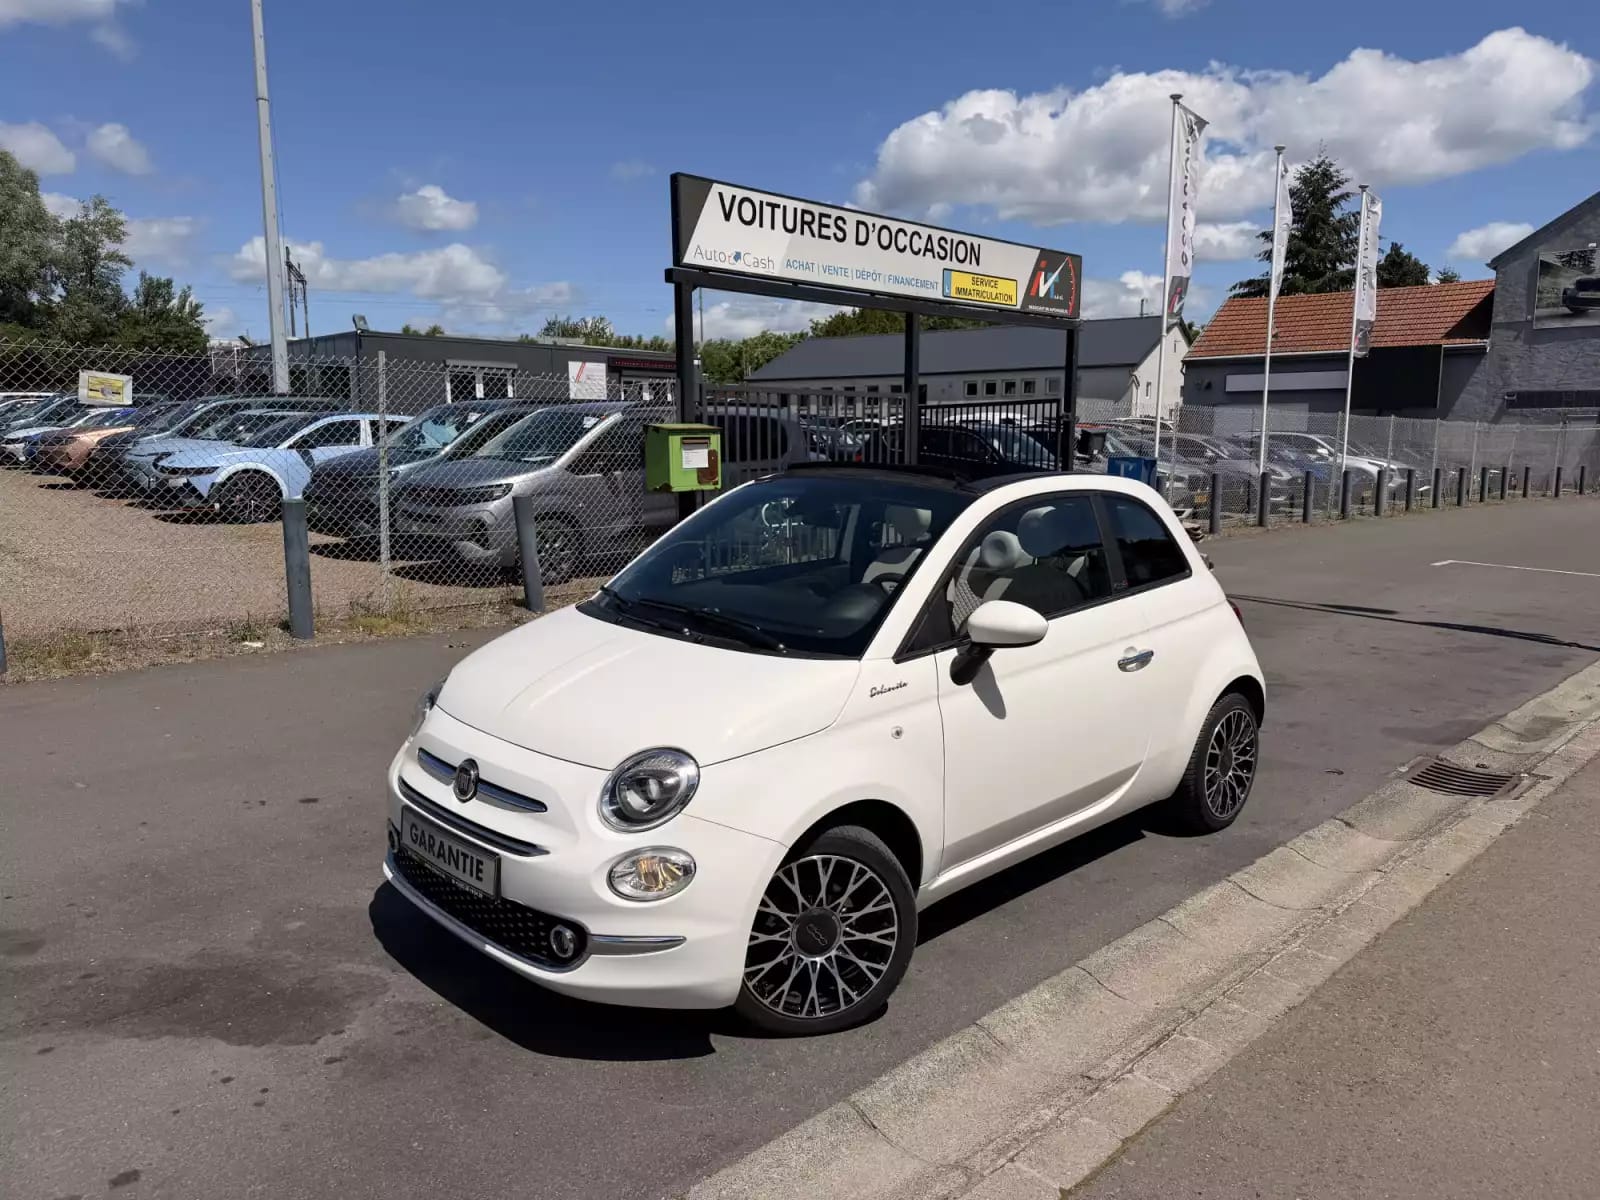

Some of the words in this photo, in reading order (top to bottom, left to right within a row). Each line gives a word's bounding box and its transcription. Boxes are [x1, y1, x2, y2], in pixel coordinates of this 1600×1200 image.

[718, 191, 847, 243] VOITURES
[855, 219, 981, 267] D'OCCASION
[693, 244, 727, 263] Auto
[743, 252, 775, 270] Cash
[785, 259, 815, 273] ACHAT
[822, 265, 849, 278] VENTE
[855, 268, 882, 282] DÉPÔT
[888, 274, 939, 291] FINANCEMENT
[971, 276, 999, 289] SERVICE
[955, 286, 1013, 303] IMMATRICULATION
[409, 823, 485, 882] GARANTIE
